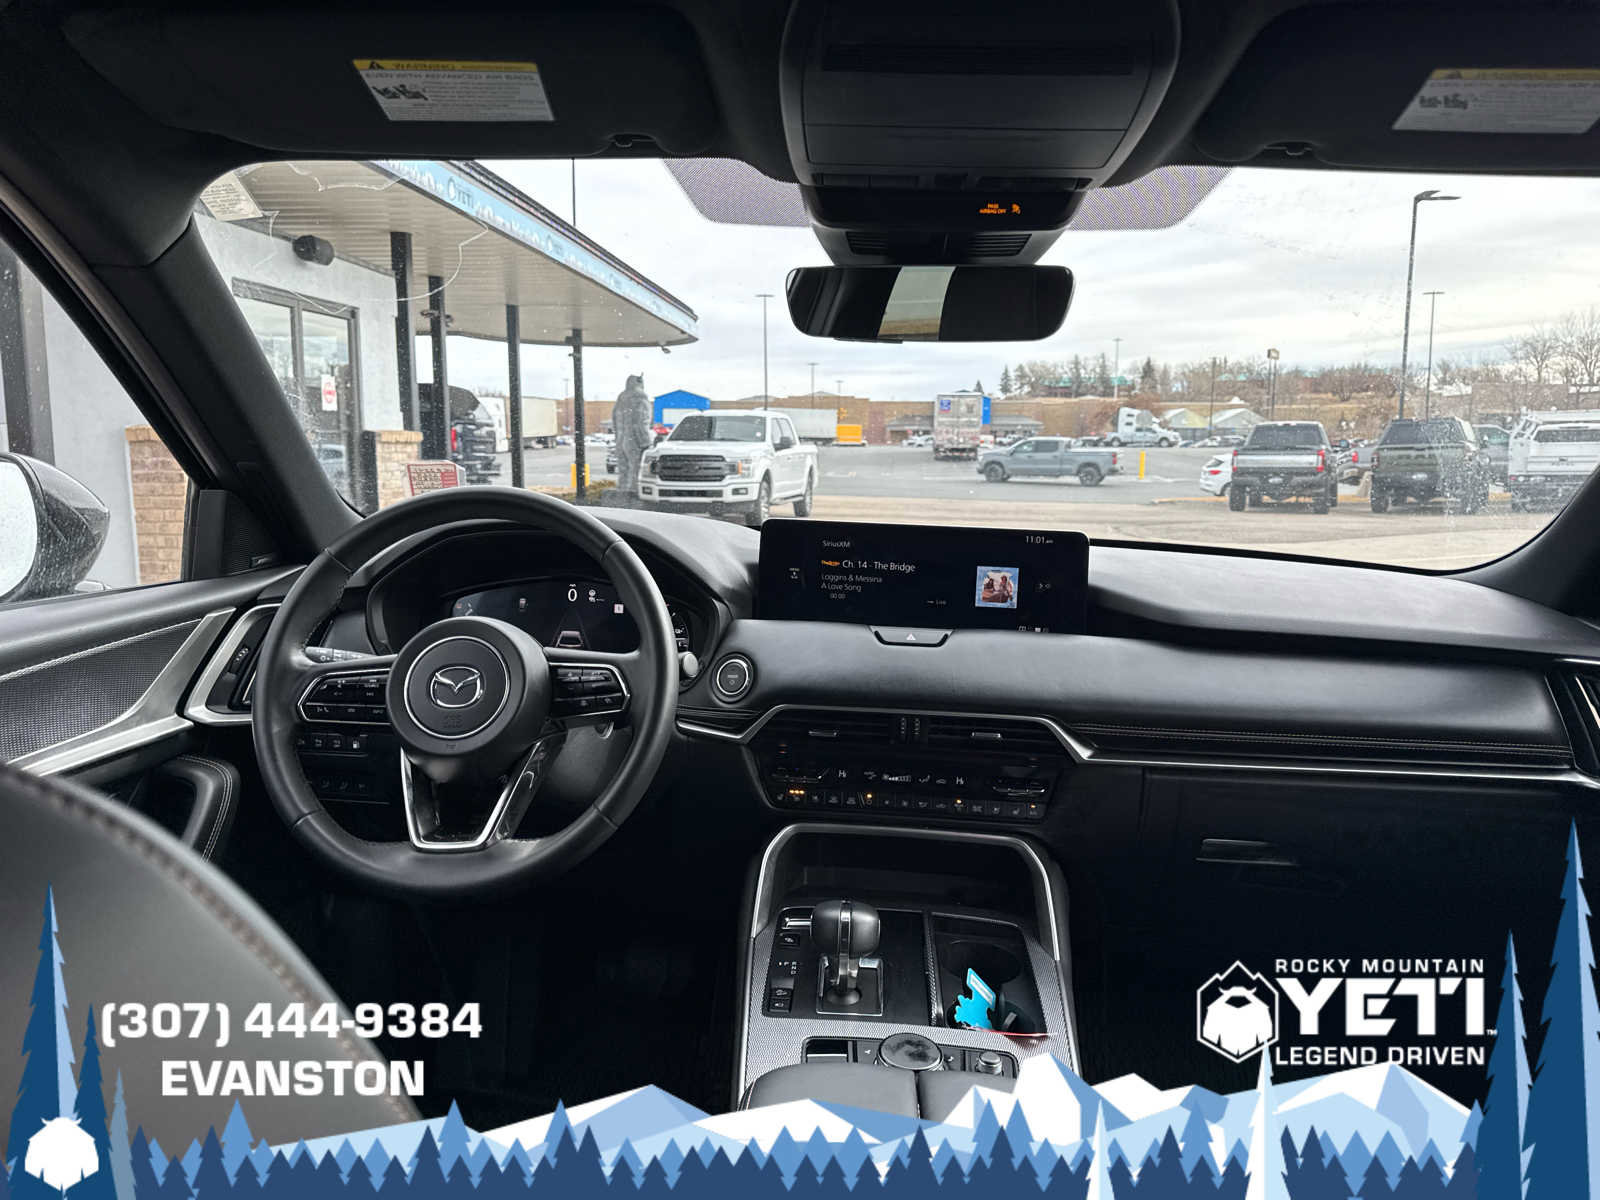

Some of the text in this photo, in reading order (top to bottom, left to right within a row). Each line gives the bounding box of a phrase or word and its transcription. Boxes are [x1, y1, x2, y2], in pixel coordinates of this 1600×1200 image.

[822, 540, 850, 548] SiriusXM
[842, 560, 855, 569] Ch.
[858, 560, 867, 569] 14
[873, 561, 888, 570] The
[889, 562, 916, 573] Bridge
[821, 574, 847, 582] Loggins
[855, 575, 882, 583] Messina
[828, 582, 843, 591] Love
[844, 583, 861, 592] Song
[567, 588, 578, 602] 0
